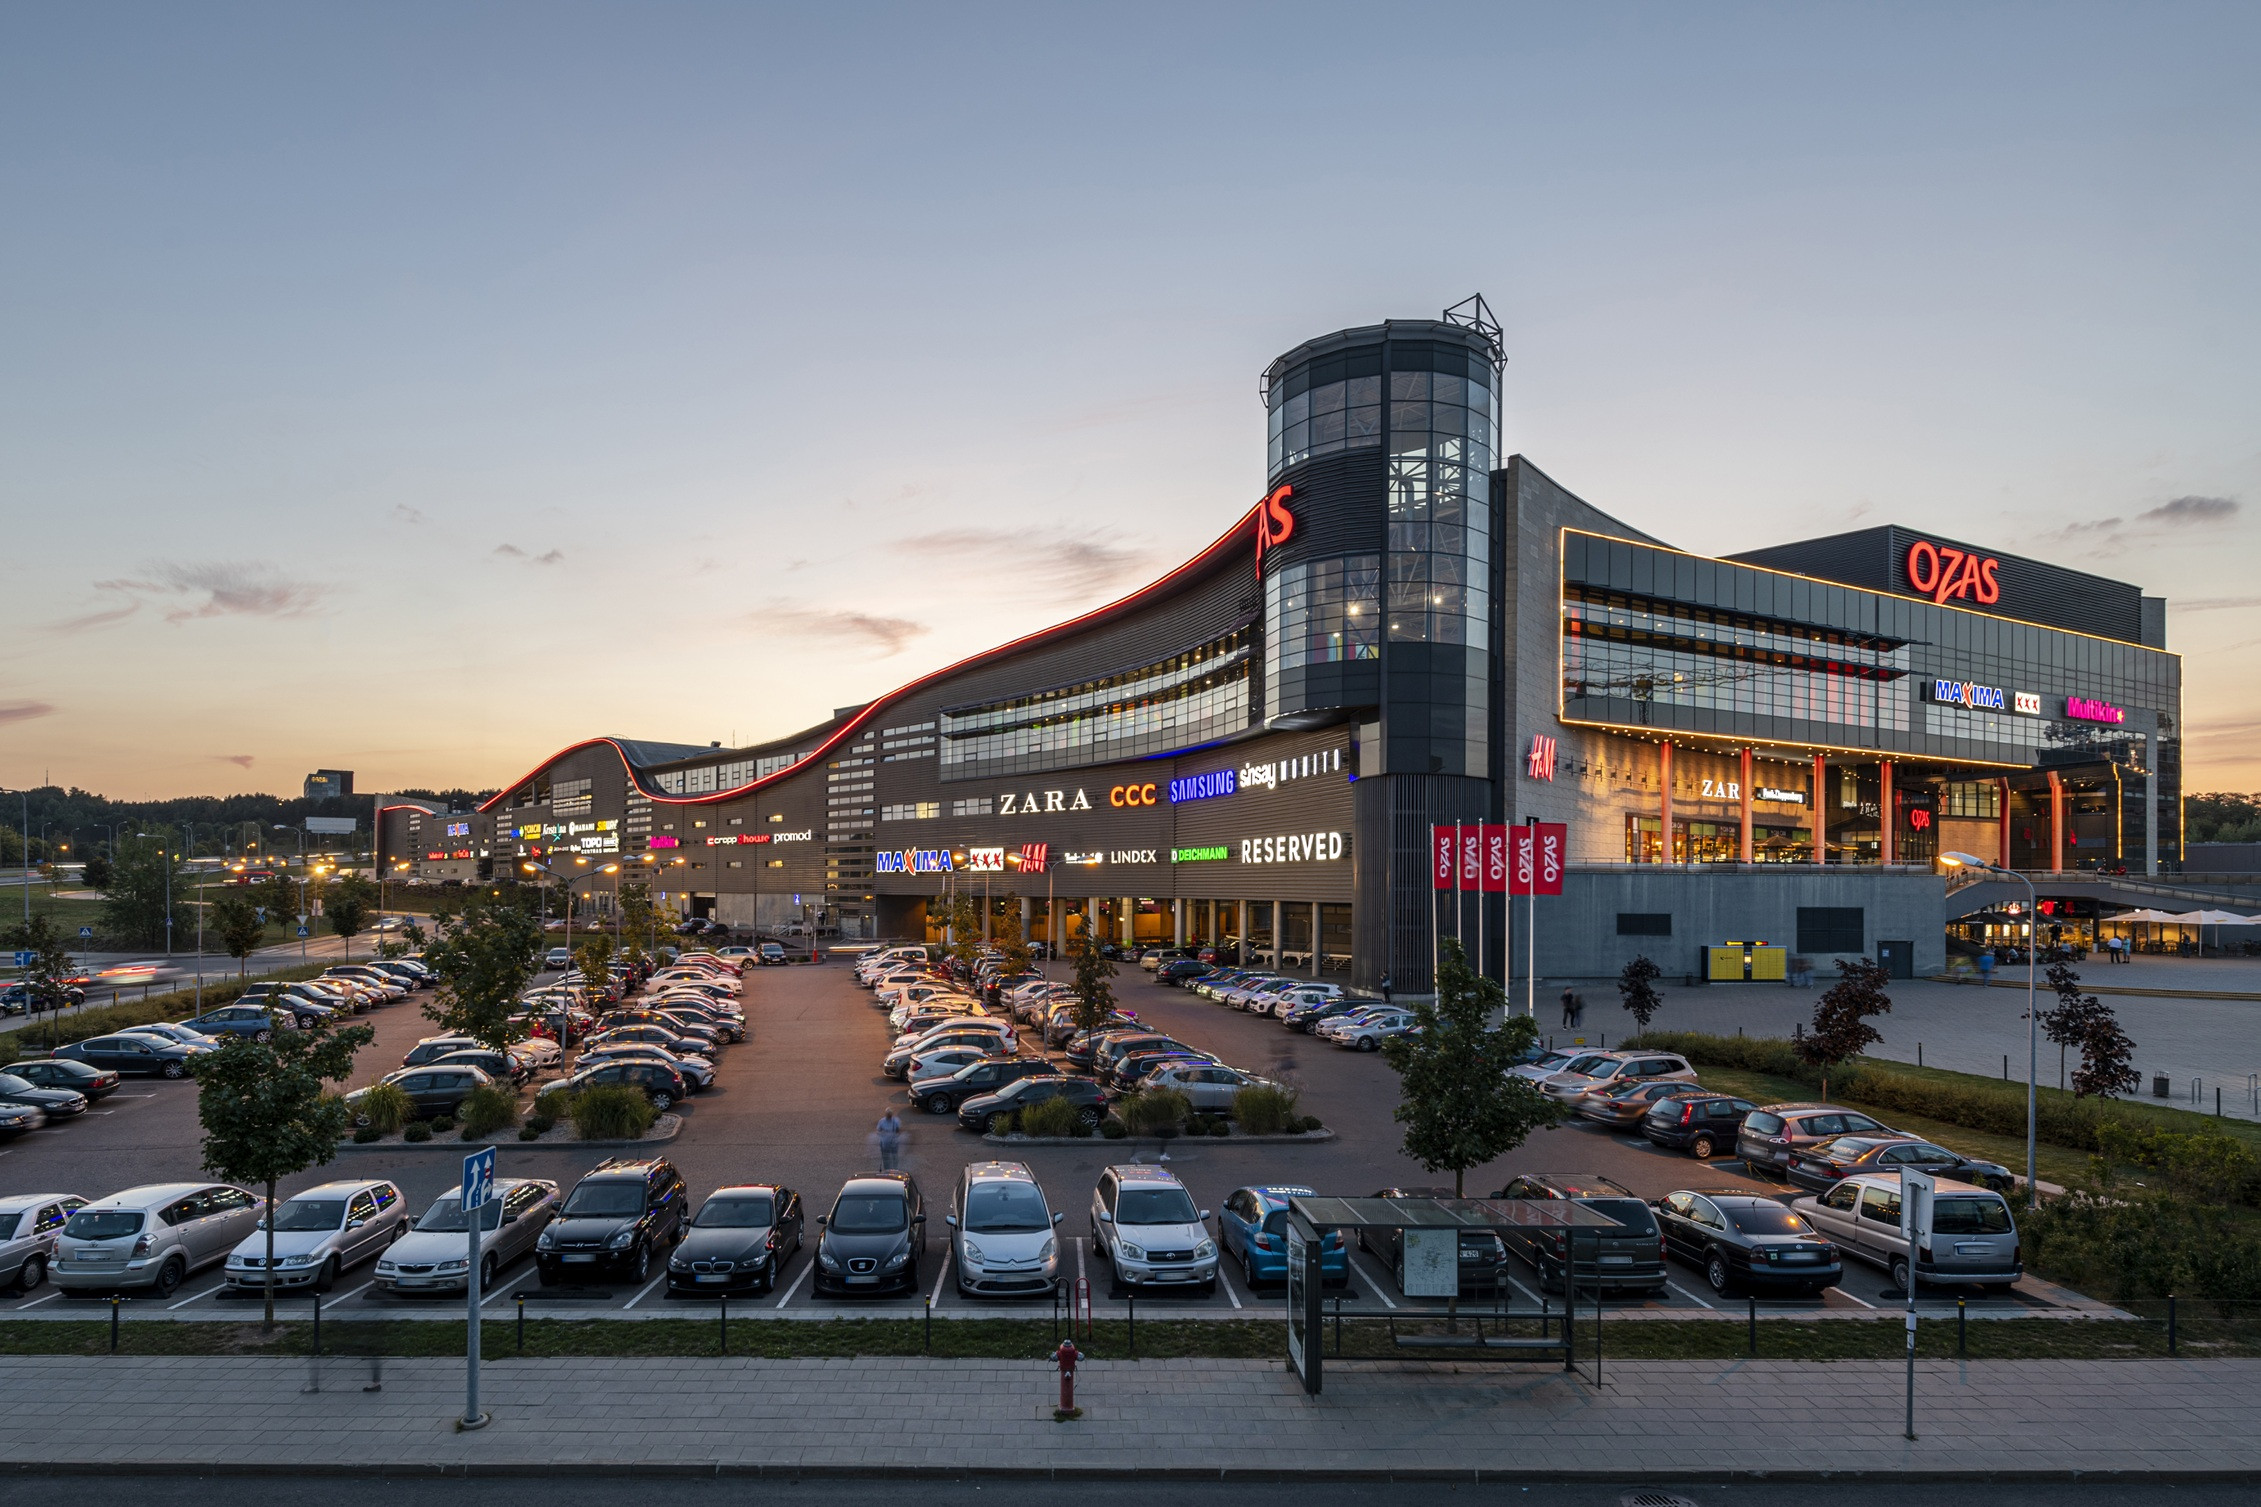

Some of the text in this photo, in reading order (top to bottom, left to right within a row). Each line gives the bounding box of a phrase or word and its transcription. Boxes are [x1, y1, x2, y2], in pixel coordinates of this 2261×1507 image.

[1256, 485, 1293, 580] AS
[1909, 541, 1999, 604] OZAS
[1935, 679, 2004, 709] MAXIMA
[1529, 734, 1556, 782] H&M
[1171, 770, 1235, 802] SAMSUNG
[1240, 763, 1276, 789] sinsay
[1702, 779, 1741, 799] ZAR
[1000, 788, 1092, 815] ZARA
[1110, 783, 1156, 807] CCC
[1912, 809, 1930, 831] OZAS
[581, 837, 602, 848] TOPO
[714, 836, 737, 845] cropp
[774, 829, 811, 844] promod
[1242, 832, 1342, 864] RESERVED
[877, 847, 953, 875] MAXIMA
[1018, 843, 1047, 873] H&M
[1111, 850, 1156, 863] LINDEX
[1179, 847, 1227, 861] DEICHMANN
[1440, 837, 1451, 878] OZAS
[1464, 837, 1480, 879] OZAS
[1490, 836, 1505, 880] OZAS
[1518, 838, 1533, 883] OZAS
[1544, 836, 1560, 882] OZAS
